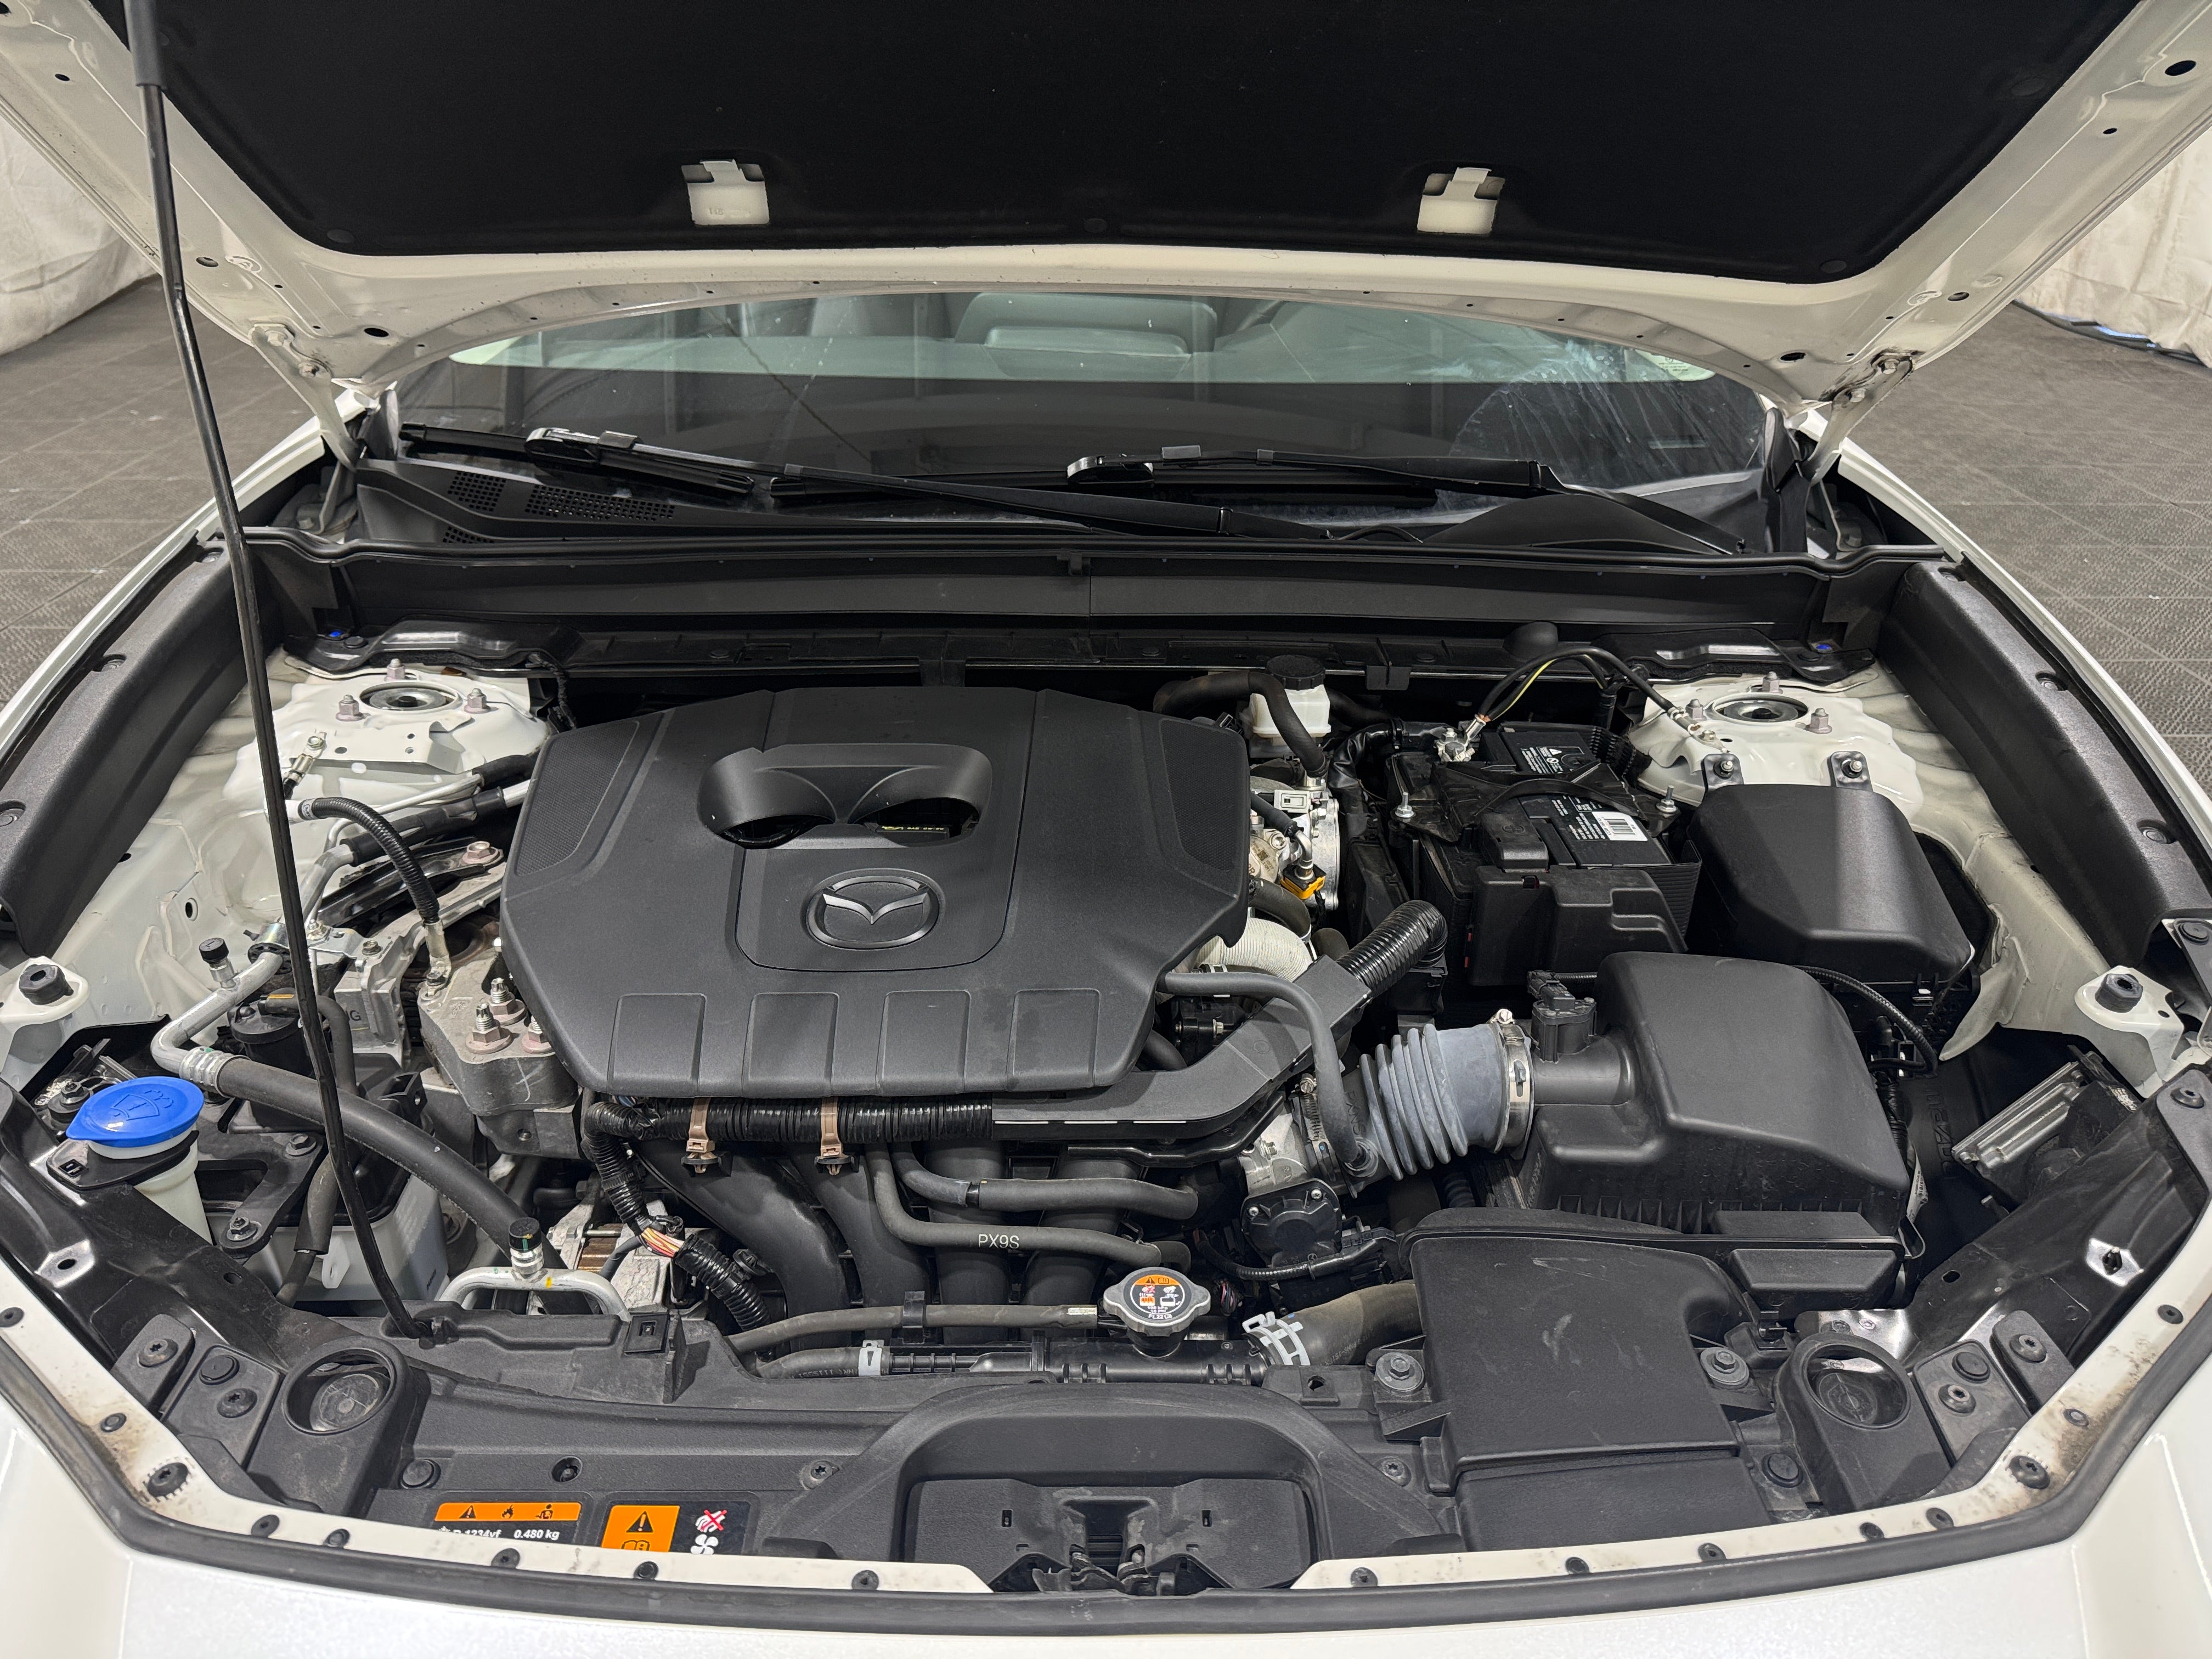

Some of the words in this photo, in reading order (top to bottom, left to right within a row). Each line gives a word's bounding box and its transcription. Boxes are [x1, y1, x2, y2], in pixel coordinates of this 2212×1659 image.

[978, 1234, 1019, 1249] PX9S
[514, 1529, 544, 1539] 0.480
[545, 1529, 560, 1541] kg
